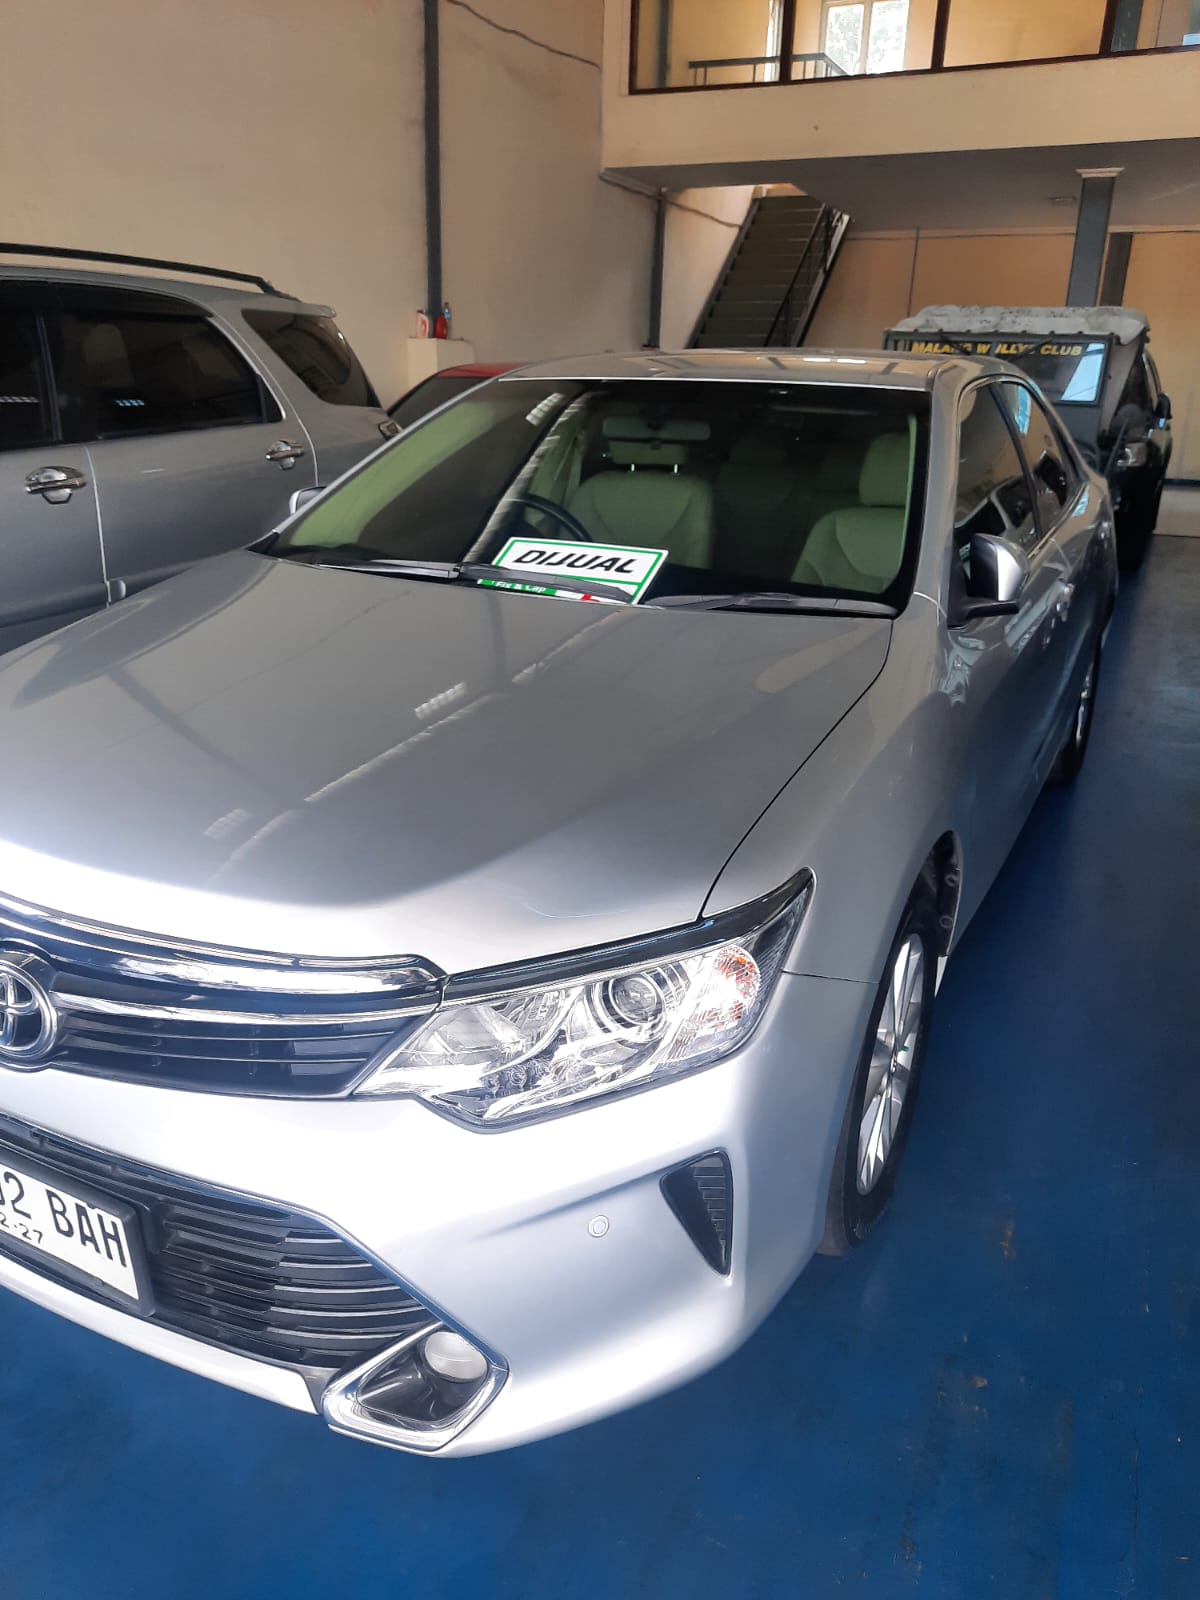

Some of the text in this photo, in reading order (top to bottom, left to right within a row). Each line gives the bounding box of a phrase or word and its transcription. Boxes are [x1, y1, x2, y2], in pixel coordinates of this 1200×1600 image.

[1040, 344, 1083, 355] CLUB
[513, 549, 638, 574] DIJUAL
[45, 1188, 127, 1268] BAH
